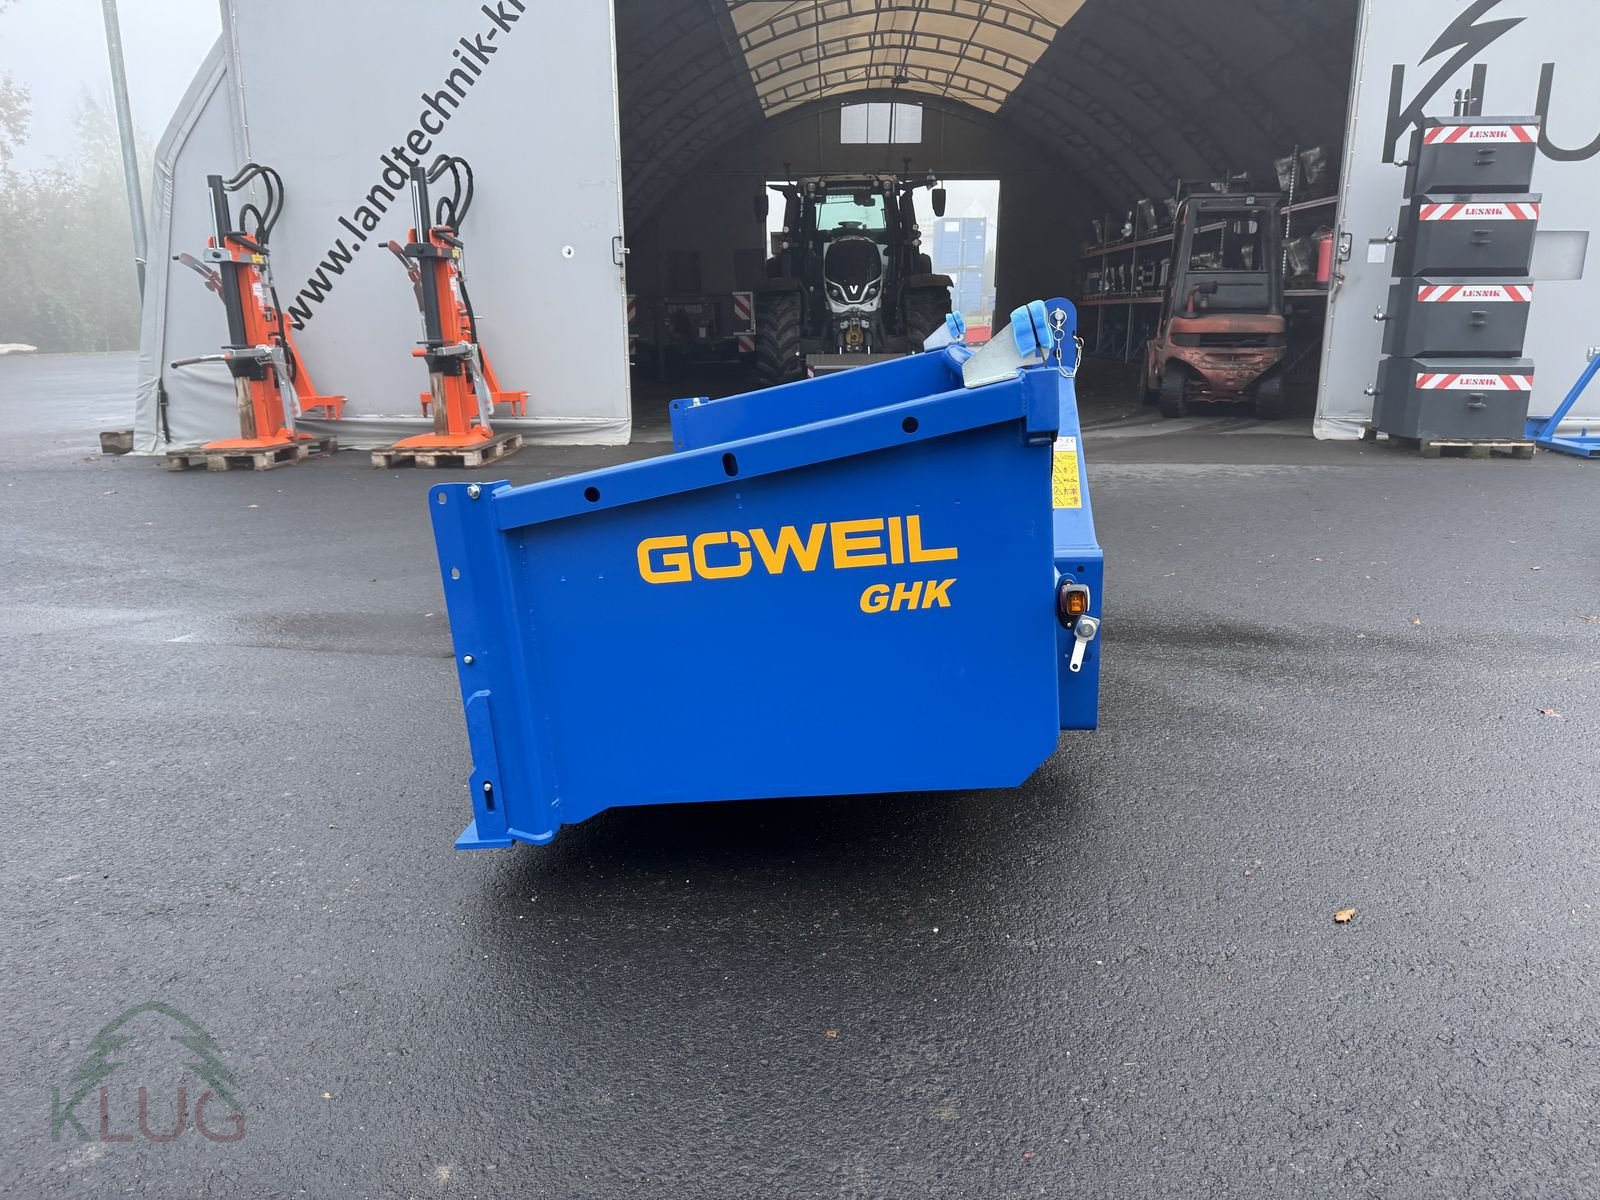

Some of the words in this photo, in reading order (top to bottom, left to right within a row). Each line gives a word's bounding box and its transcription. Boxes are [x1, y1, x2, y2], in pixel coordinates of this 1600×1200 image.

[1468, 130, 1508, 139] LESNIK
[1464, 207, 1504, 216] LESNIK
[1462, 289, 1502, 298] LESNIK
[1459, 377, 1498, 386] LESNIK
[859, 578, 958, 614] GHK
